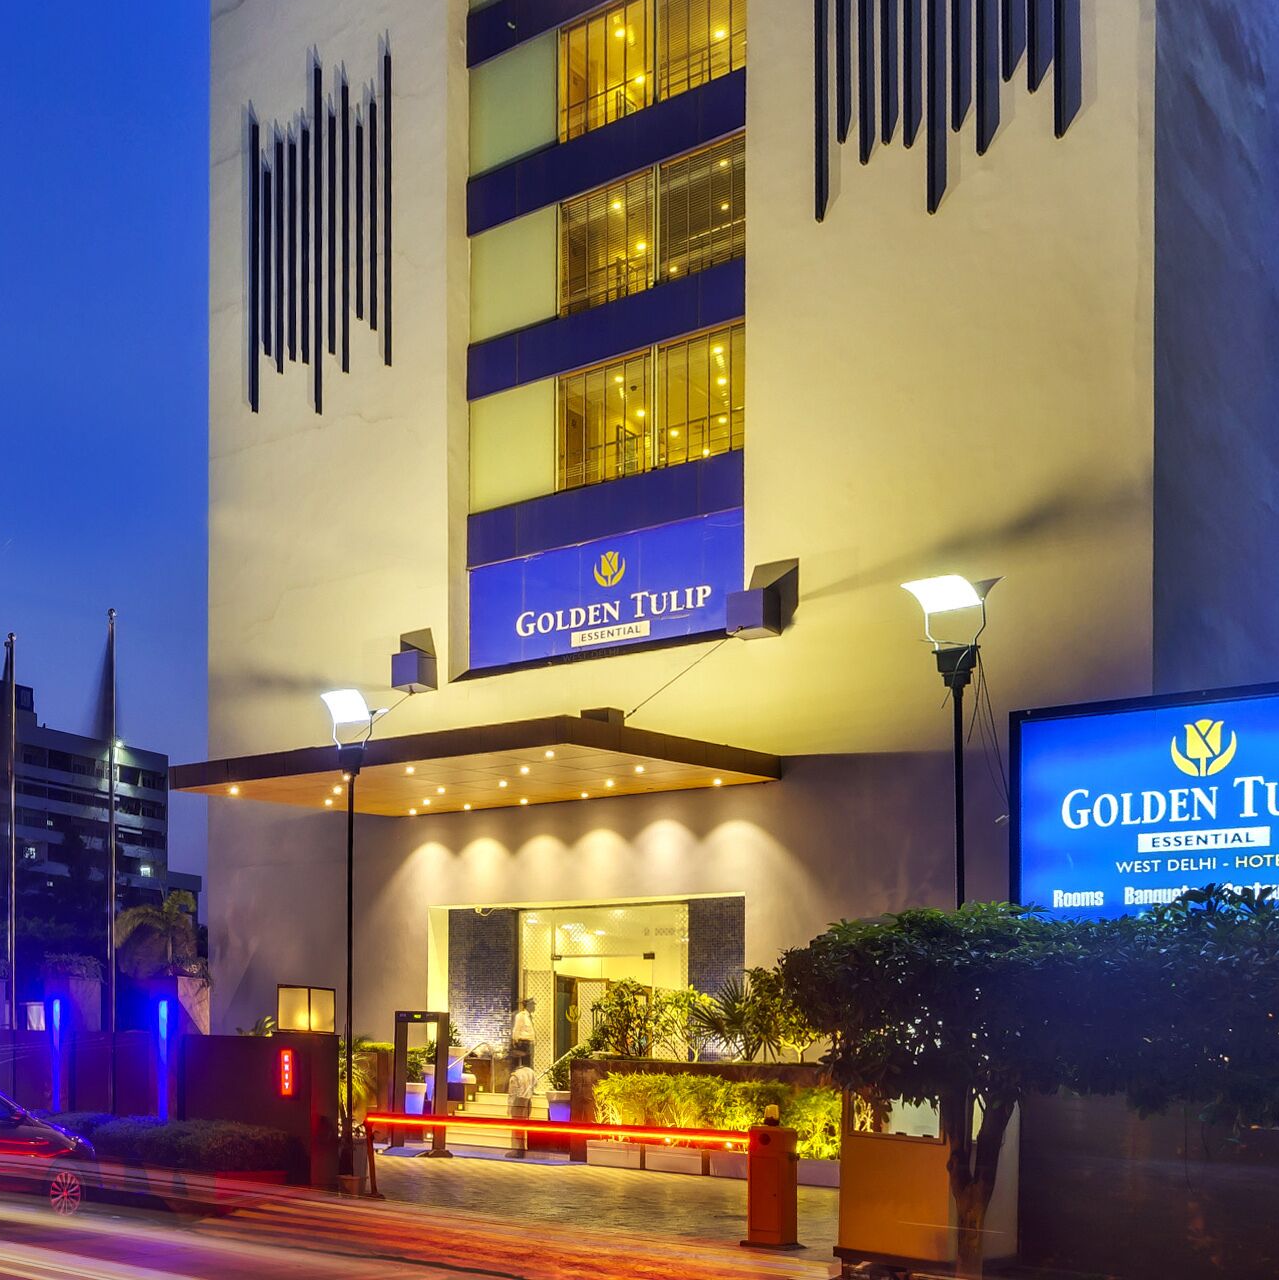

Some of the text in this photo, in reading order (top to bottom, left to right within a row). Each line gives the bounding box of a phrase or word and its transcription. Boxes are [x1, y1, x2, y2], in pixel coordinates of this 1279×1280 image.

[515, 585, 711, 637] GOLDEN TULIP
[581, 625, 640, 642] ESSENTIAL
[1061, 786, 1218, 829] GOLDEN
[1152, 831, 1255, 848] ESSENTIAL
[1115, 859, 1161, 874] WEST
[1167, 857, 1217, 872] DELHI
[1053, 889, 1104, 908] Rooms
